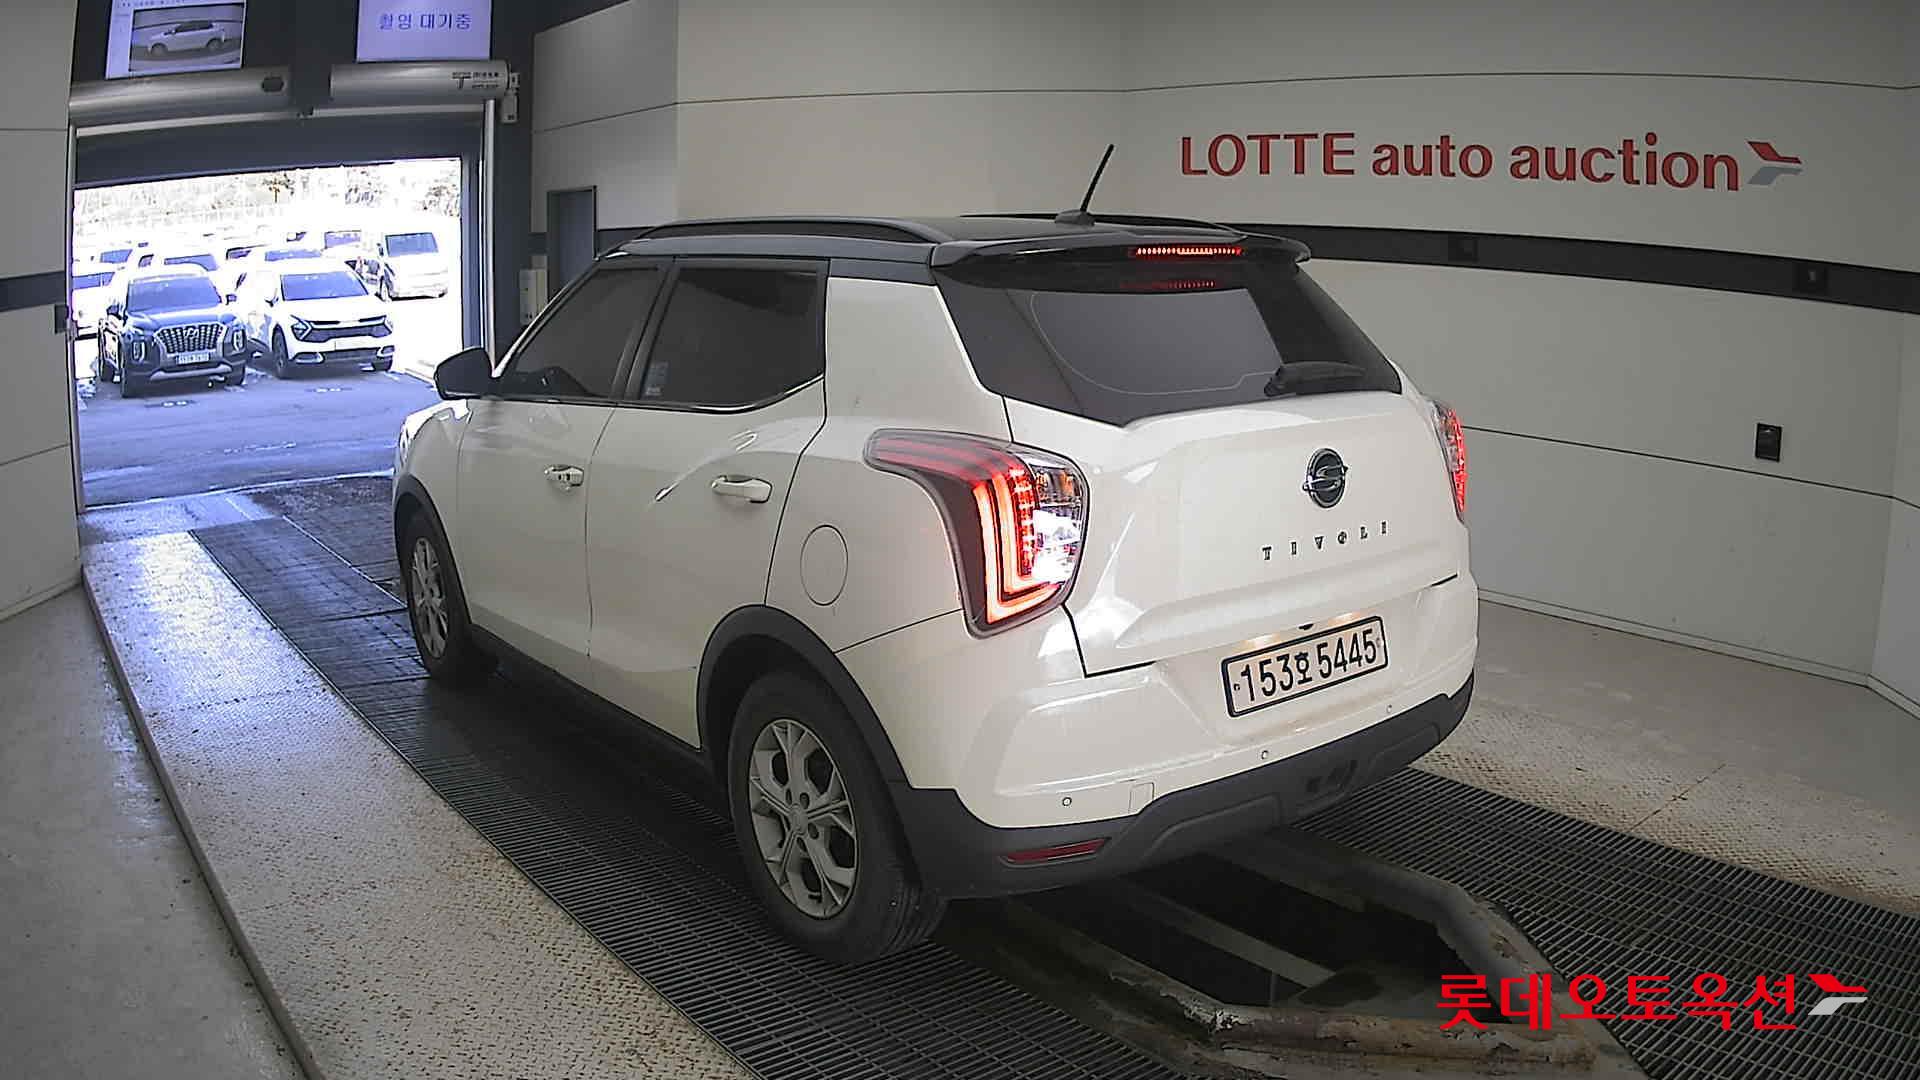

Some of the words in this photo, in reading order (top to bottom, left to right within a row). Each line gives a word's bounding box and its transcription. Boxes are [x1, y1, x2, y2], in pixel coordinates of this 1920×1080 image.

[419, 11, 472, 29] 대기중
[1181, 132, 1355, 176] LOTTE
[1372, 135, 1494, 178] auto
[1509, 132, 1740, 191] auction
[1262, 521, 1388, 561] TIVOLI
